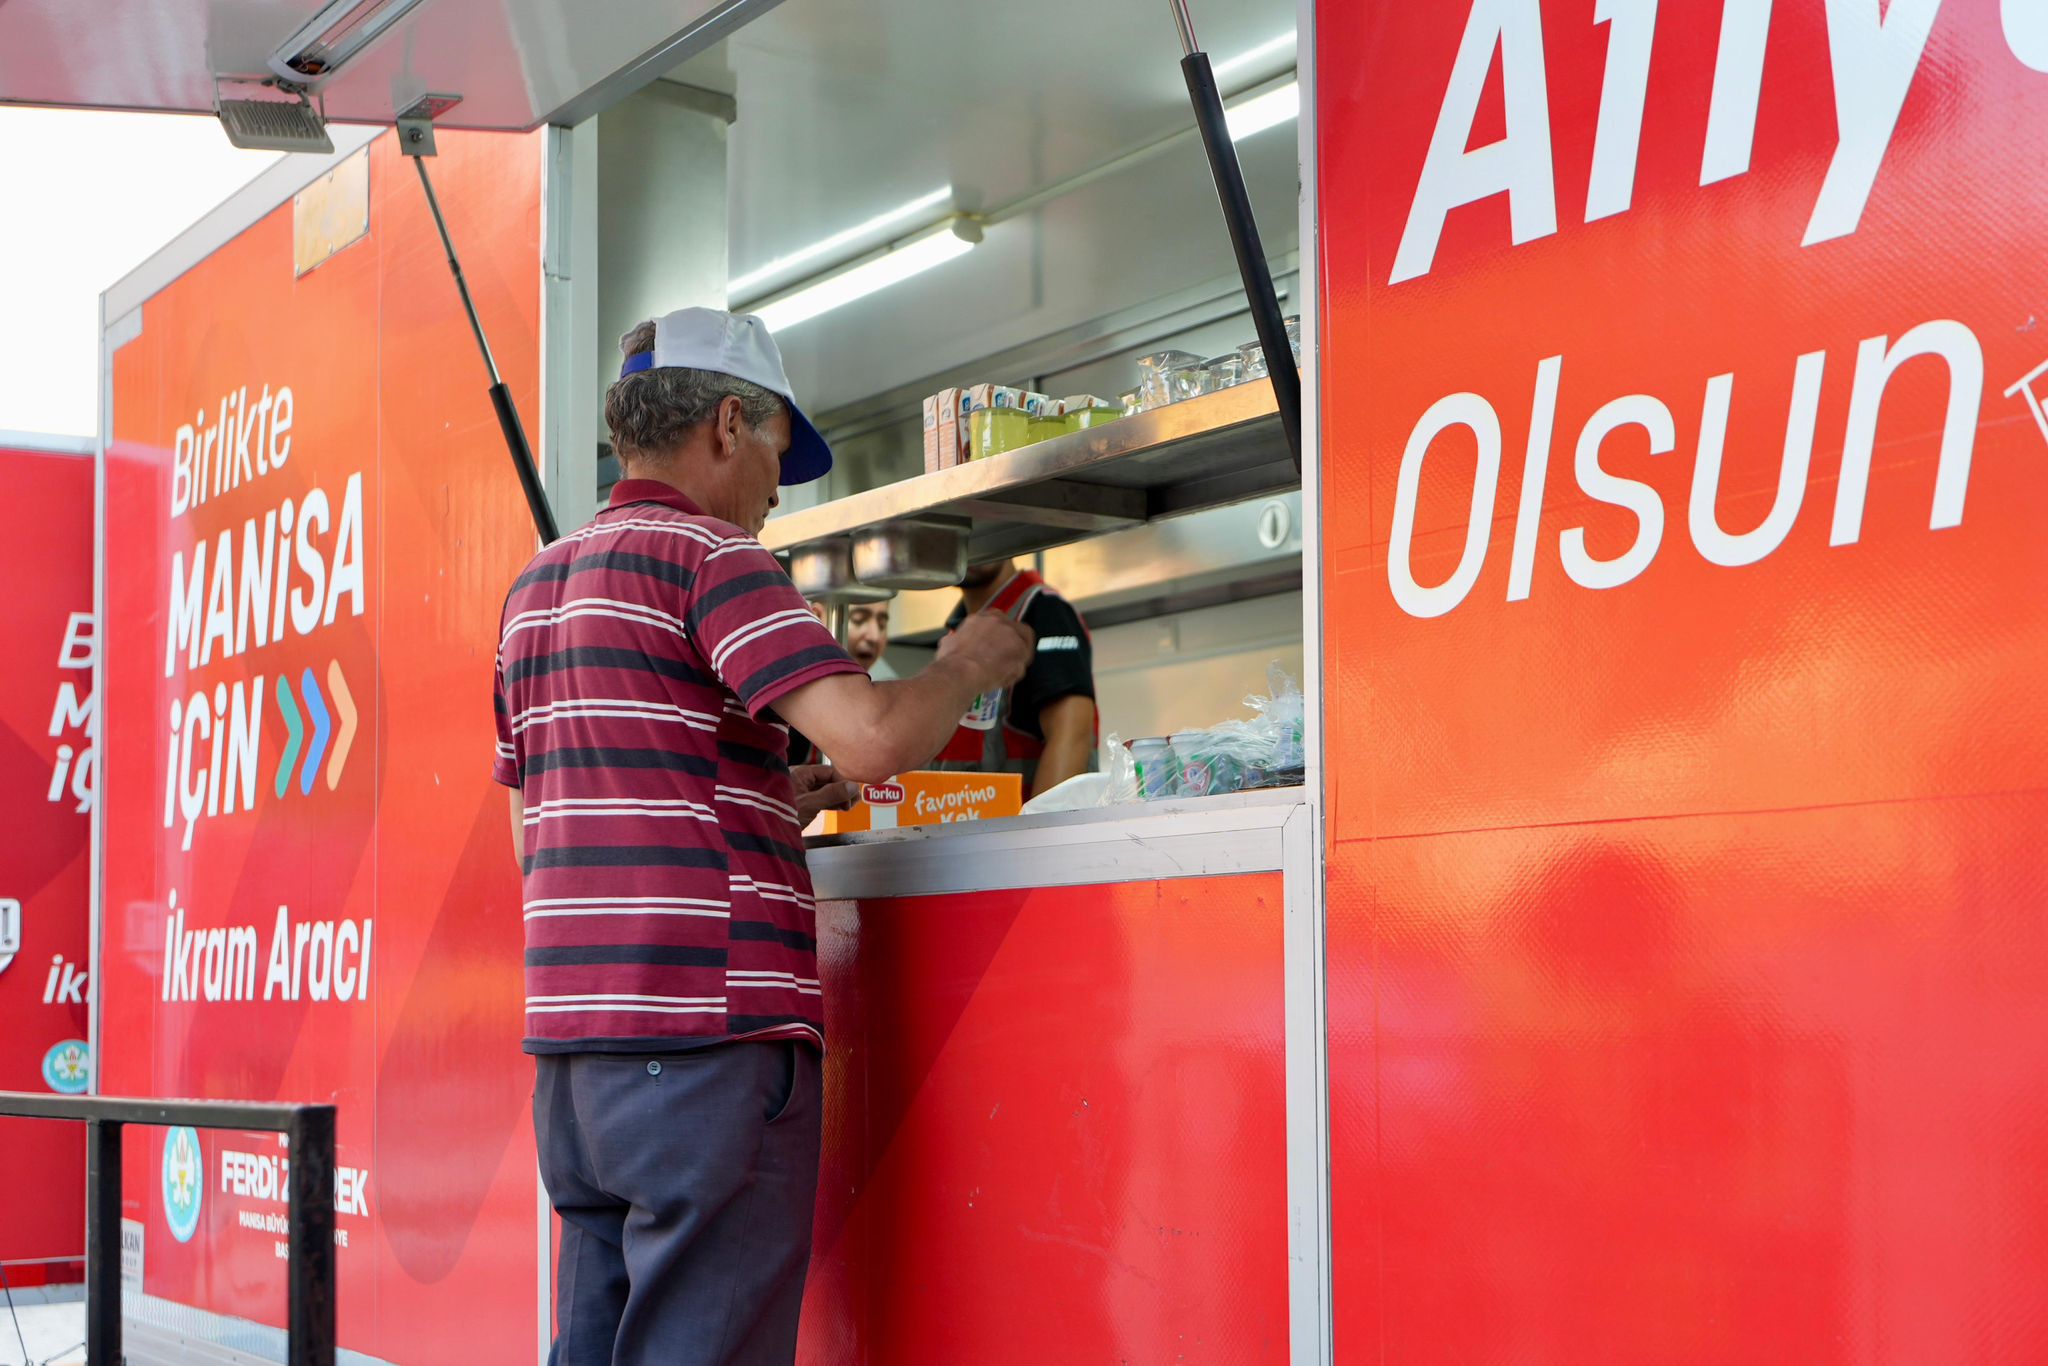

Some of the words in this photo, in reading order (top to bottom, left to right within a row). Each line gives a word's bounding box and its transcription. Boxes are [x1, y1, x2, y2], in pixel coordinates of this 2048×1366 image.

[171, 383, 293, 519] Birlikte
[1387, 319, 1984, 618] Olsun
[867, 787, 900, 800] Torku
[914, 784, 997, 816] favorimo
[263, 905, 372, 1003] Aracı
